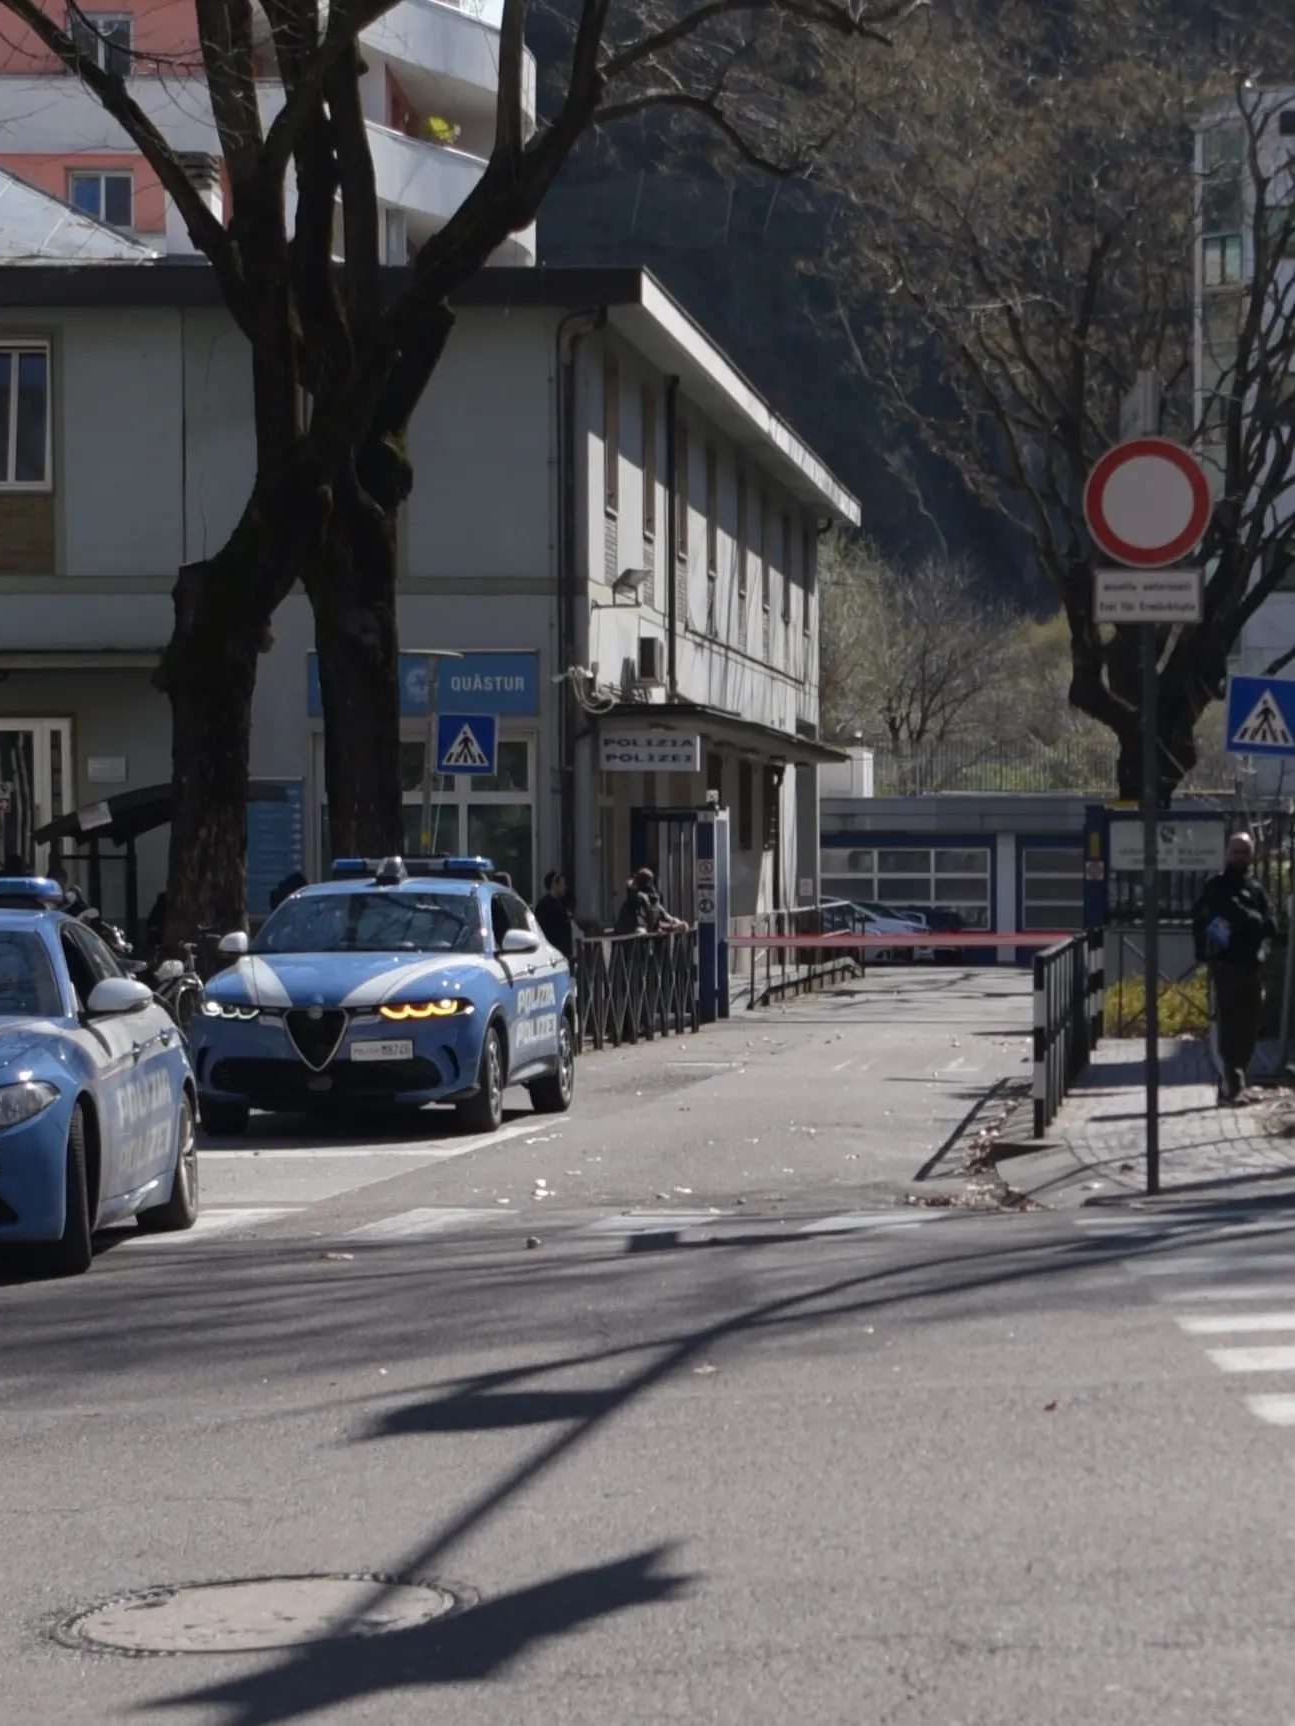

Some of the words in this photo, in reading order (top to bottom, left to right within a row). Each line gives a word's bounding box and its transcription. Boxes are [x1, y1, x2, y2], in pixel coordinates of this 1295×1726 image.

[603, 738, 694, 748] POLIZIA
[605, 754, 692, 763] POLIZEI
[517, 982, 556, 1015] POLIZIA
[516, 1012, 557, 1049] POLIZEI
[116, 1067, 172, 1131] POLIZIA
[118, 1118, 172, 1174] POLIZEI
